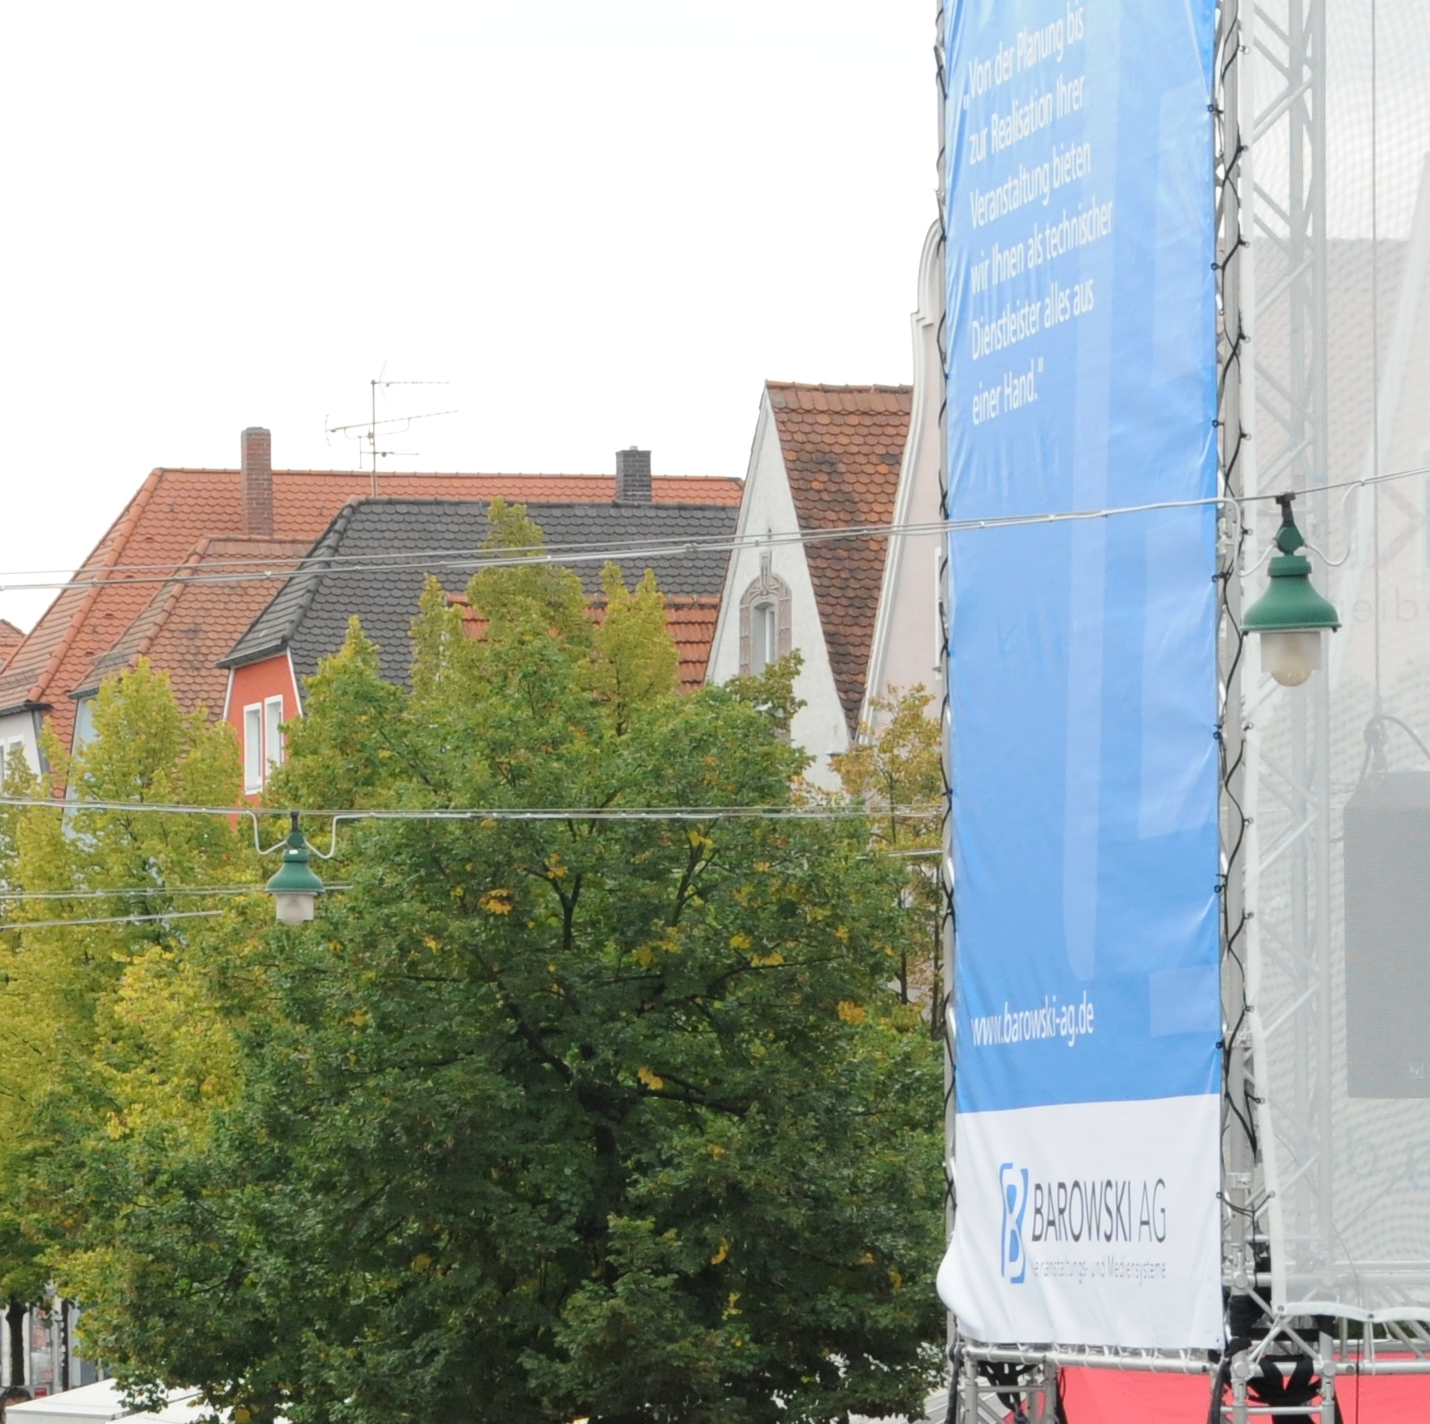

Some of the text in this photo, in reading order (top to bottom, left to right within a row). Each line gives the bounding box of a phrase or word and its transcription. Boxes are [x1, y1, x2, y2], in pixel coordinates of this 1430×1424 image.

[995, 40, 1014, 86] der
[1017, 18, 1064, 72] Planung
[1067, 0, 1084, 44] bis
[969, 73, 1085, 165] zur Realisation Ihrer
[970, 141, 1091, 229] Veranstaltung bieten
[971, 195, 1113, 294] wir Ihnen als technischer
[972, 278, 1094, 361] Dienstleister alles aus
[972, 381, 1001, 426] einer
[971, 990, 1094, 1047] www.barowski-ag.de
[1031, 1178, 1167, 1243] BAROWSKI AG
